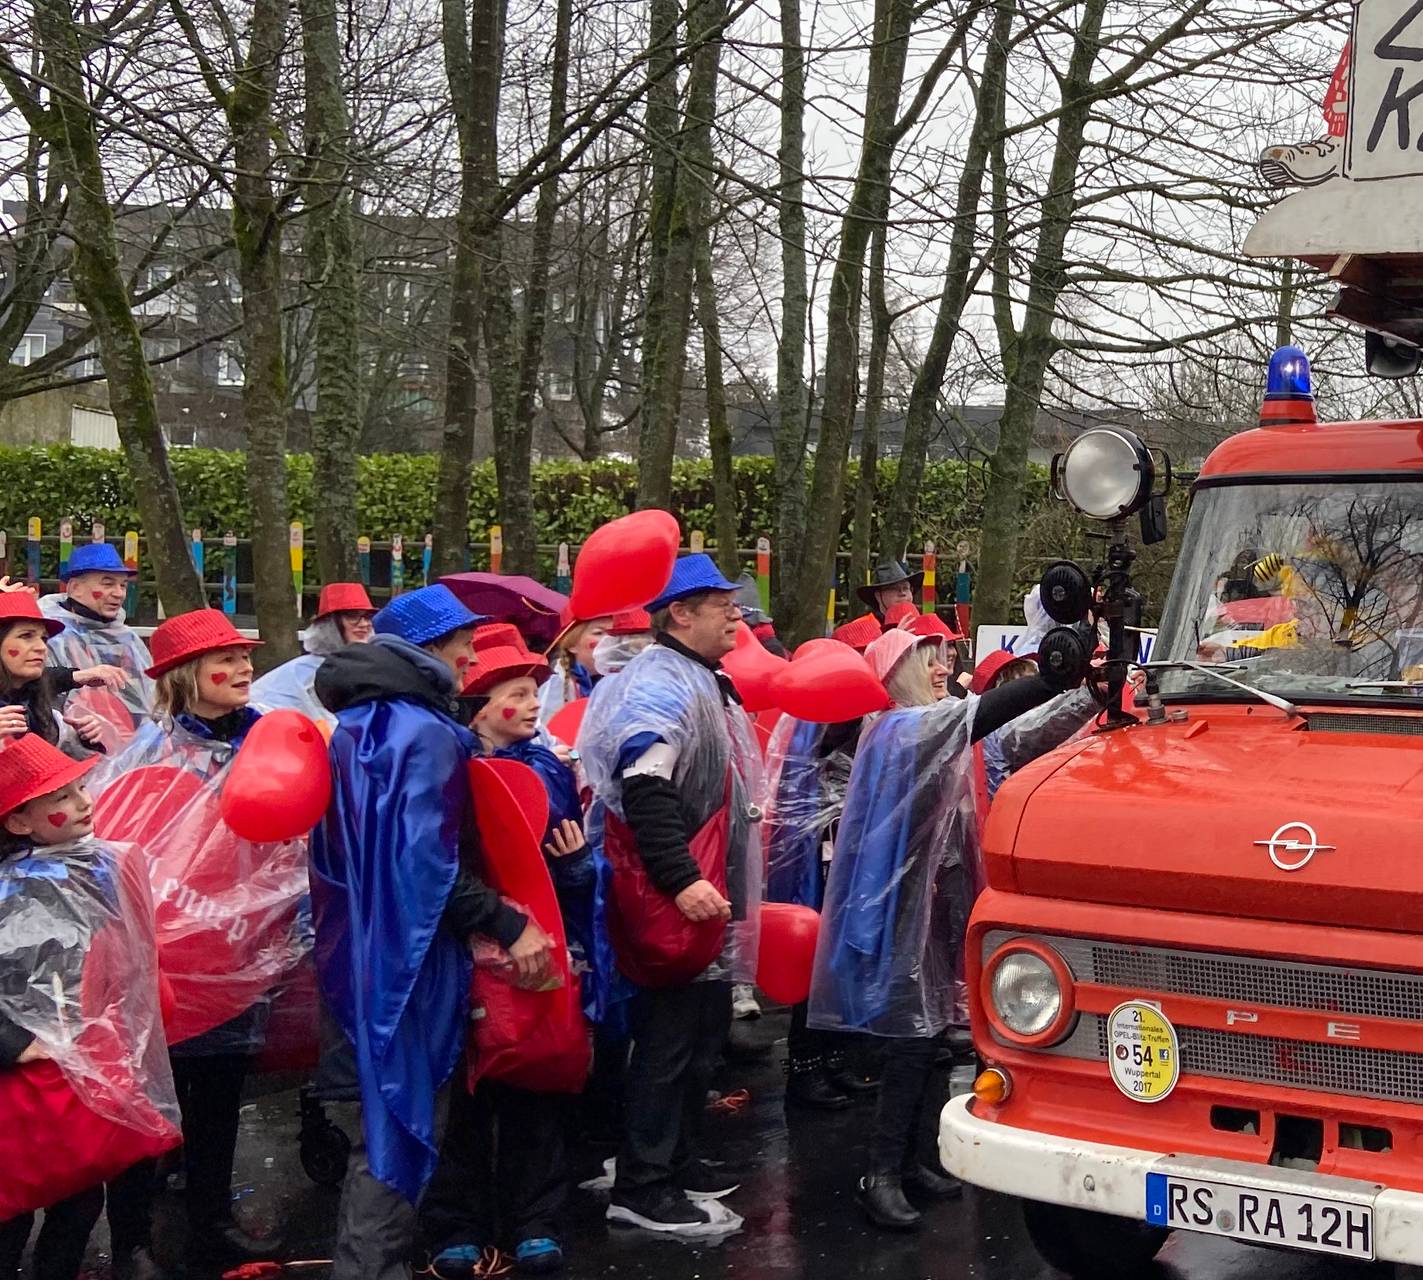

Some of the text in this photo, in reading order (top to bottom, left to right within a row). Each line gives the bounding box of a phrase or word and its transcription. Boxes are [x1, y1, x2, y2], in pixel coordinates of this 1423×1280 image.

[1133, 1045, 1153, 1067] 54
[1125, 1067, 1161, 1078] Wuppertal
[1133, 1081, 1152, 1093] 2017
[1153, 1183, 1370, 1252] D RS RA 12H
